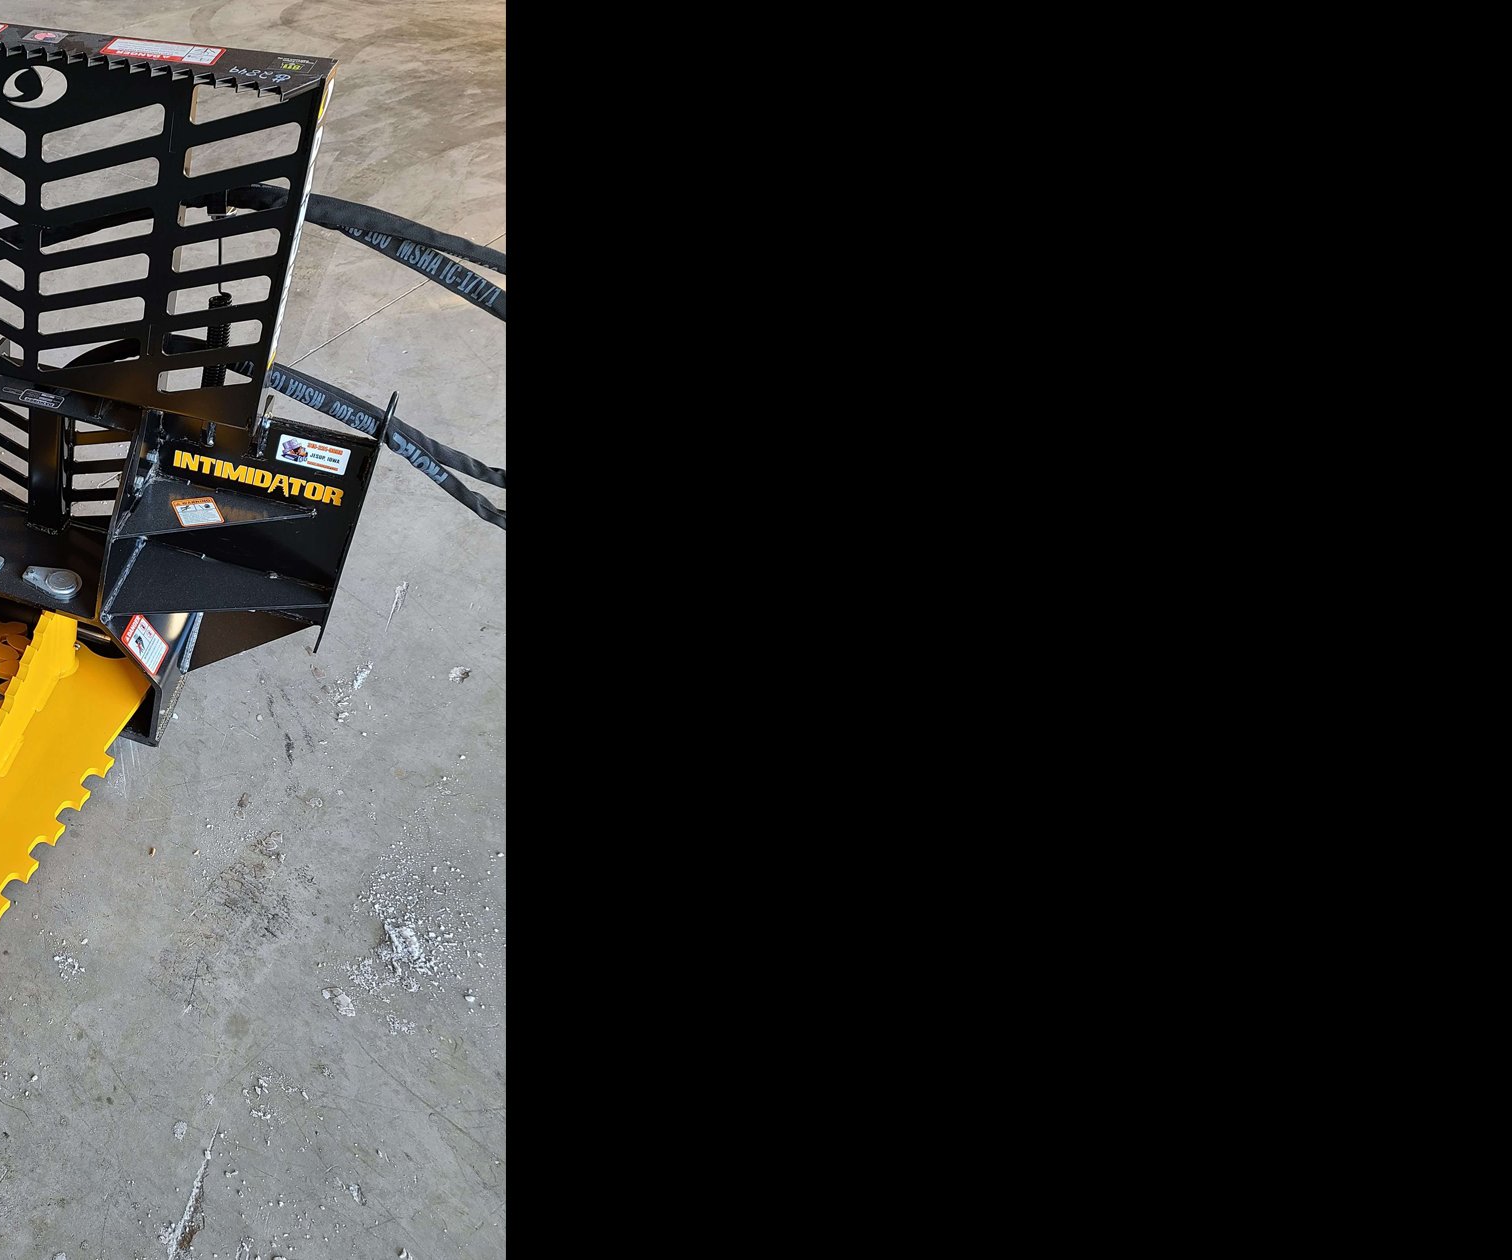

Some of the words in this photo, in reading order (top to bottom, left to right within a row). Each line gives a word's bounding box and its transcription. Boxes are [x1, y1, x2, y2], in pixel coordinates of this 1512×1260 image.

[396, 240, 444, 275] MSHA
[286, 379, 326, 409] MSHA
[173, 450, 345, 506] INTIMIDATOR
